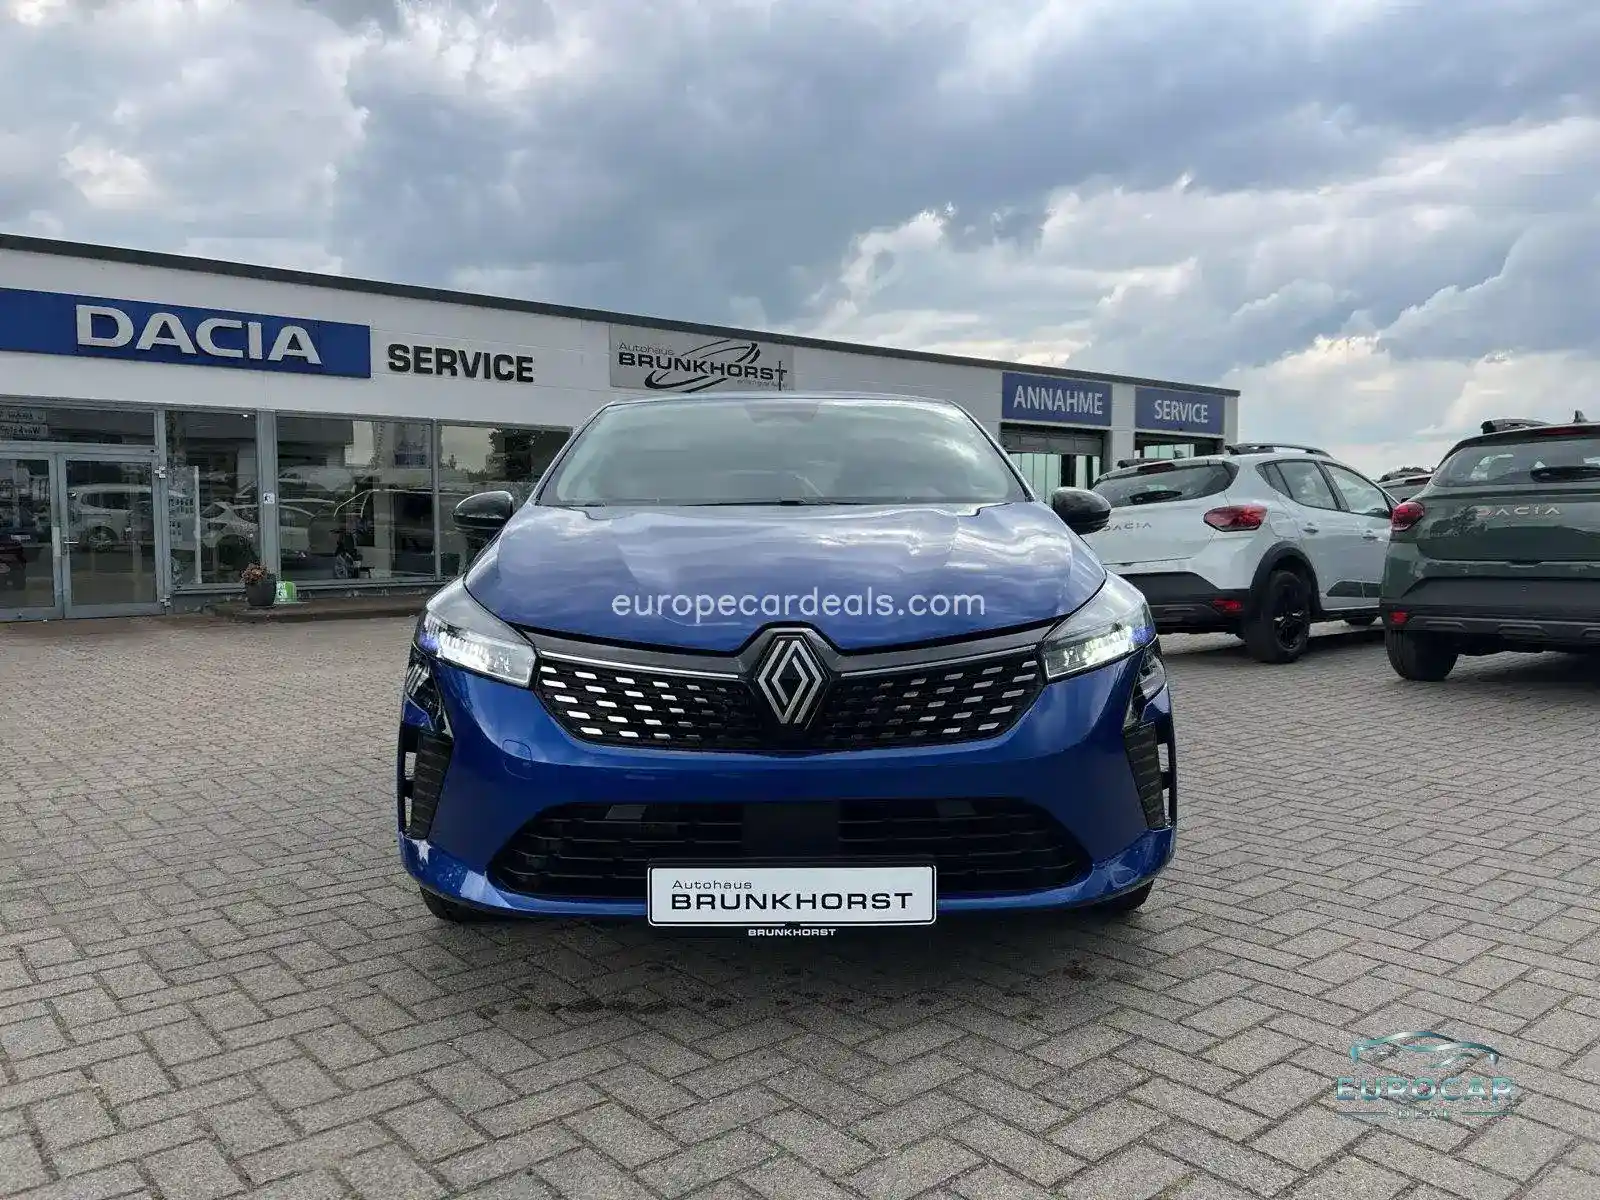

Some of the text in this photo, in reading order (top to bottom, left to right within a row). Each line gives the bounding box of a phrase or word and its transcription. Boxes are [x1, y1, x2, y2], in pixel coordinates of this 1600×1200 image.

[76, 304, 322, 365] DACIA
[618, 341, 674, 356] Autohaus
[387, 343, 534, 383] SERVICE
[618, 352, 788, 381] BRUNKHORST
[1013, 385, 1103, 415] ANNAHME
[1154, 400, 1209, 423] SERVICE
[1476, 506, 1560, 517] DACIA
[672, 880, 752, 890] Autohaus
[671, 893, 913, 910] BRUNKHORST
